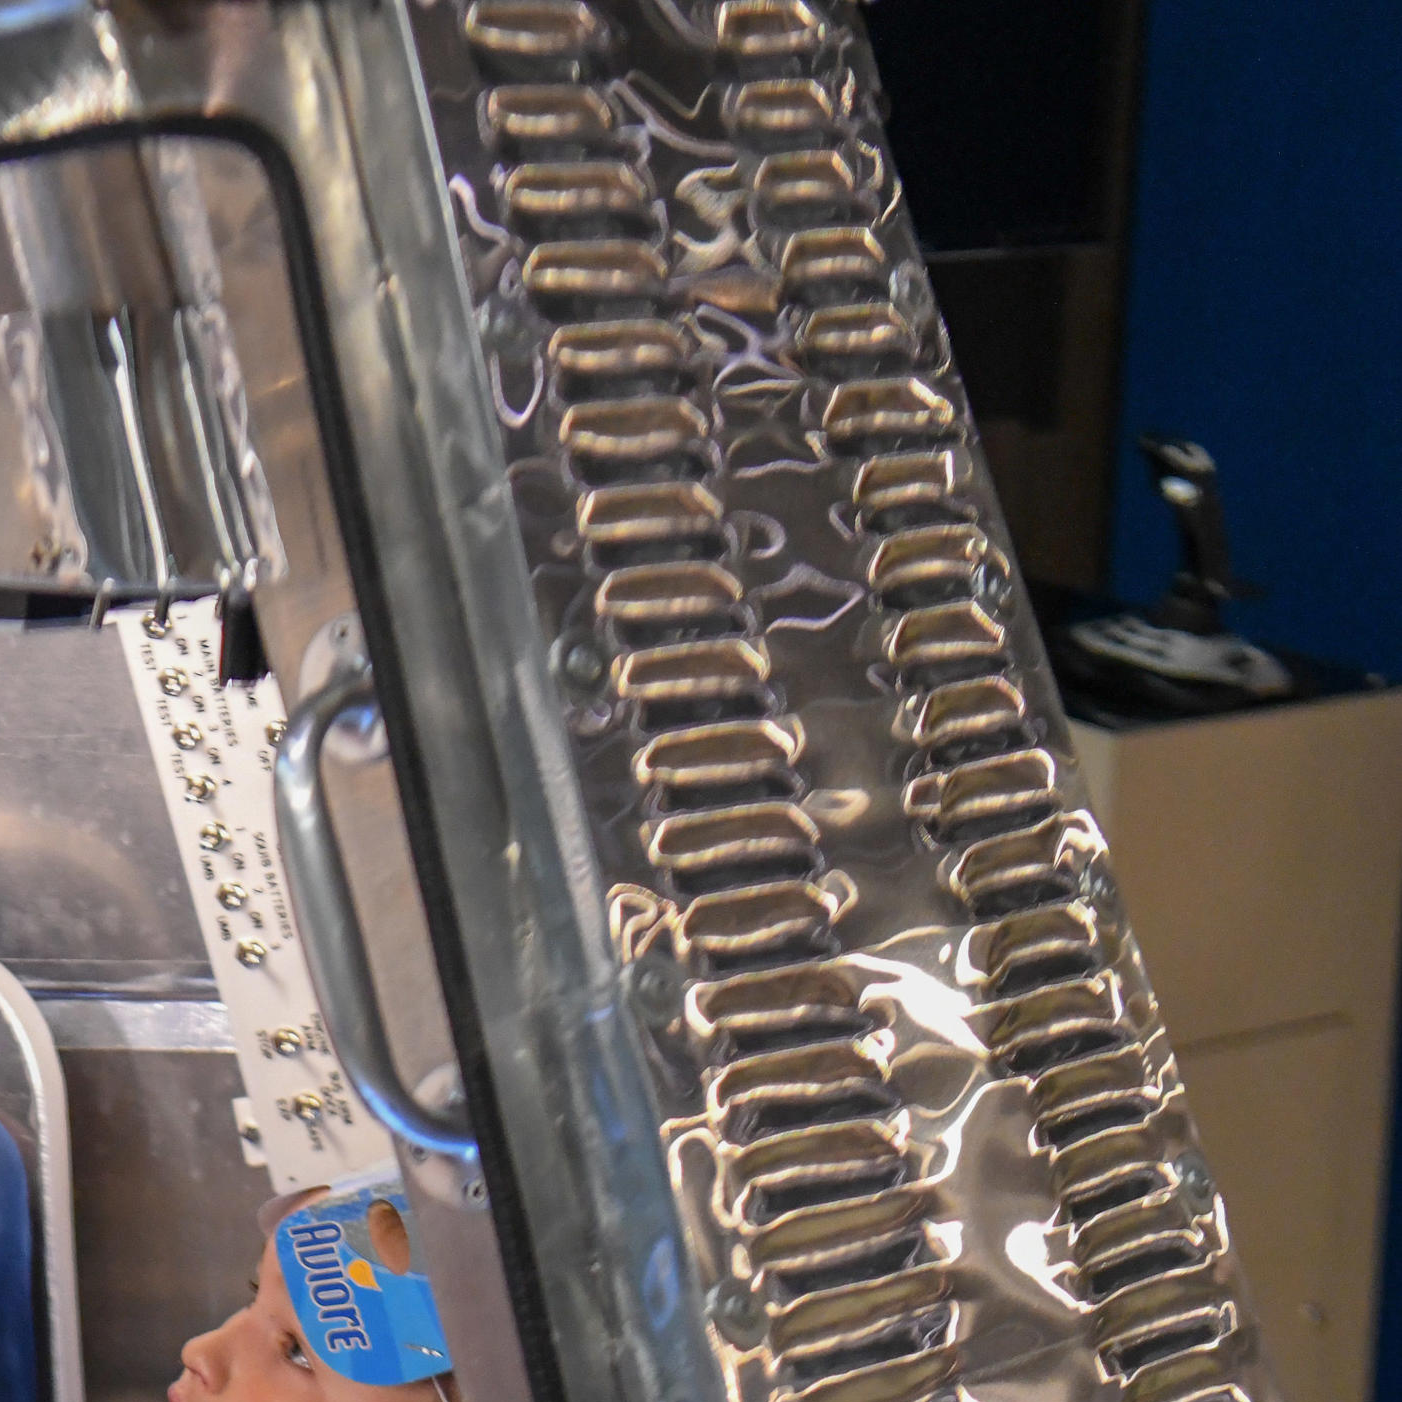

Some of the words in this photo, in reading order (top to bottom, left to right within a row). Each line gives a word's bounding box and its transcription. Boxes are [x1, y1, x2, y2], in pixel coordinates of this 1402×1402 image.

[141, 644, 156, 670] TEST
[175, 638, 188, 655] ON
[193, 695, 205, 713] ON
[198, 639, 217, 673] MAIN
[210, 678, 238, 747] BATTERIES
[156, 699, 172, 726] TEST
[172, 753, 188, 779] TEST
[207, 747, 221, 765] ON
[232, 852, 245, 870] ON
[265, 872, 293, 940] BATTERIES
[249, 911, 263, 929] ON
